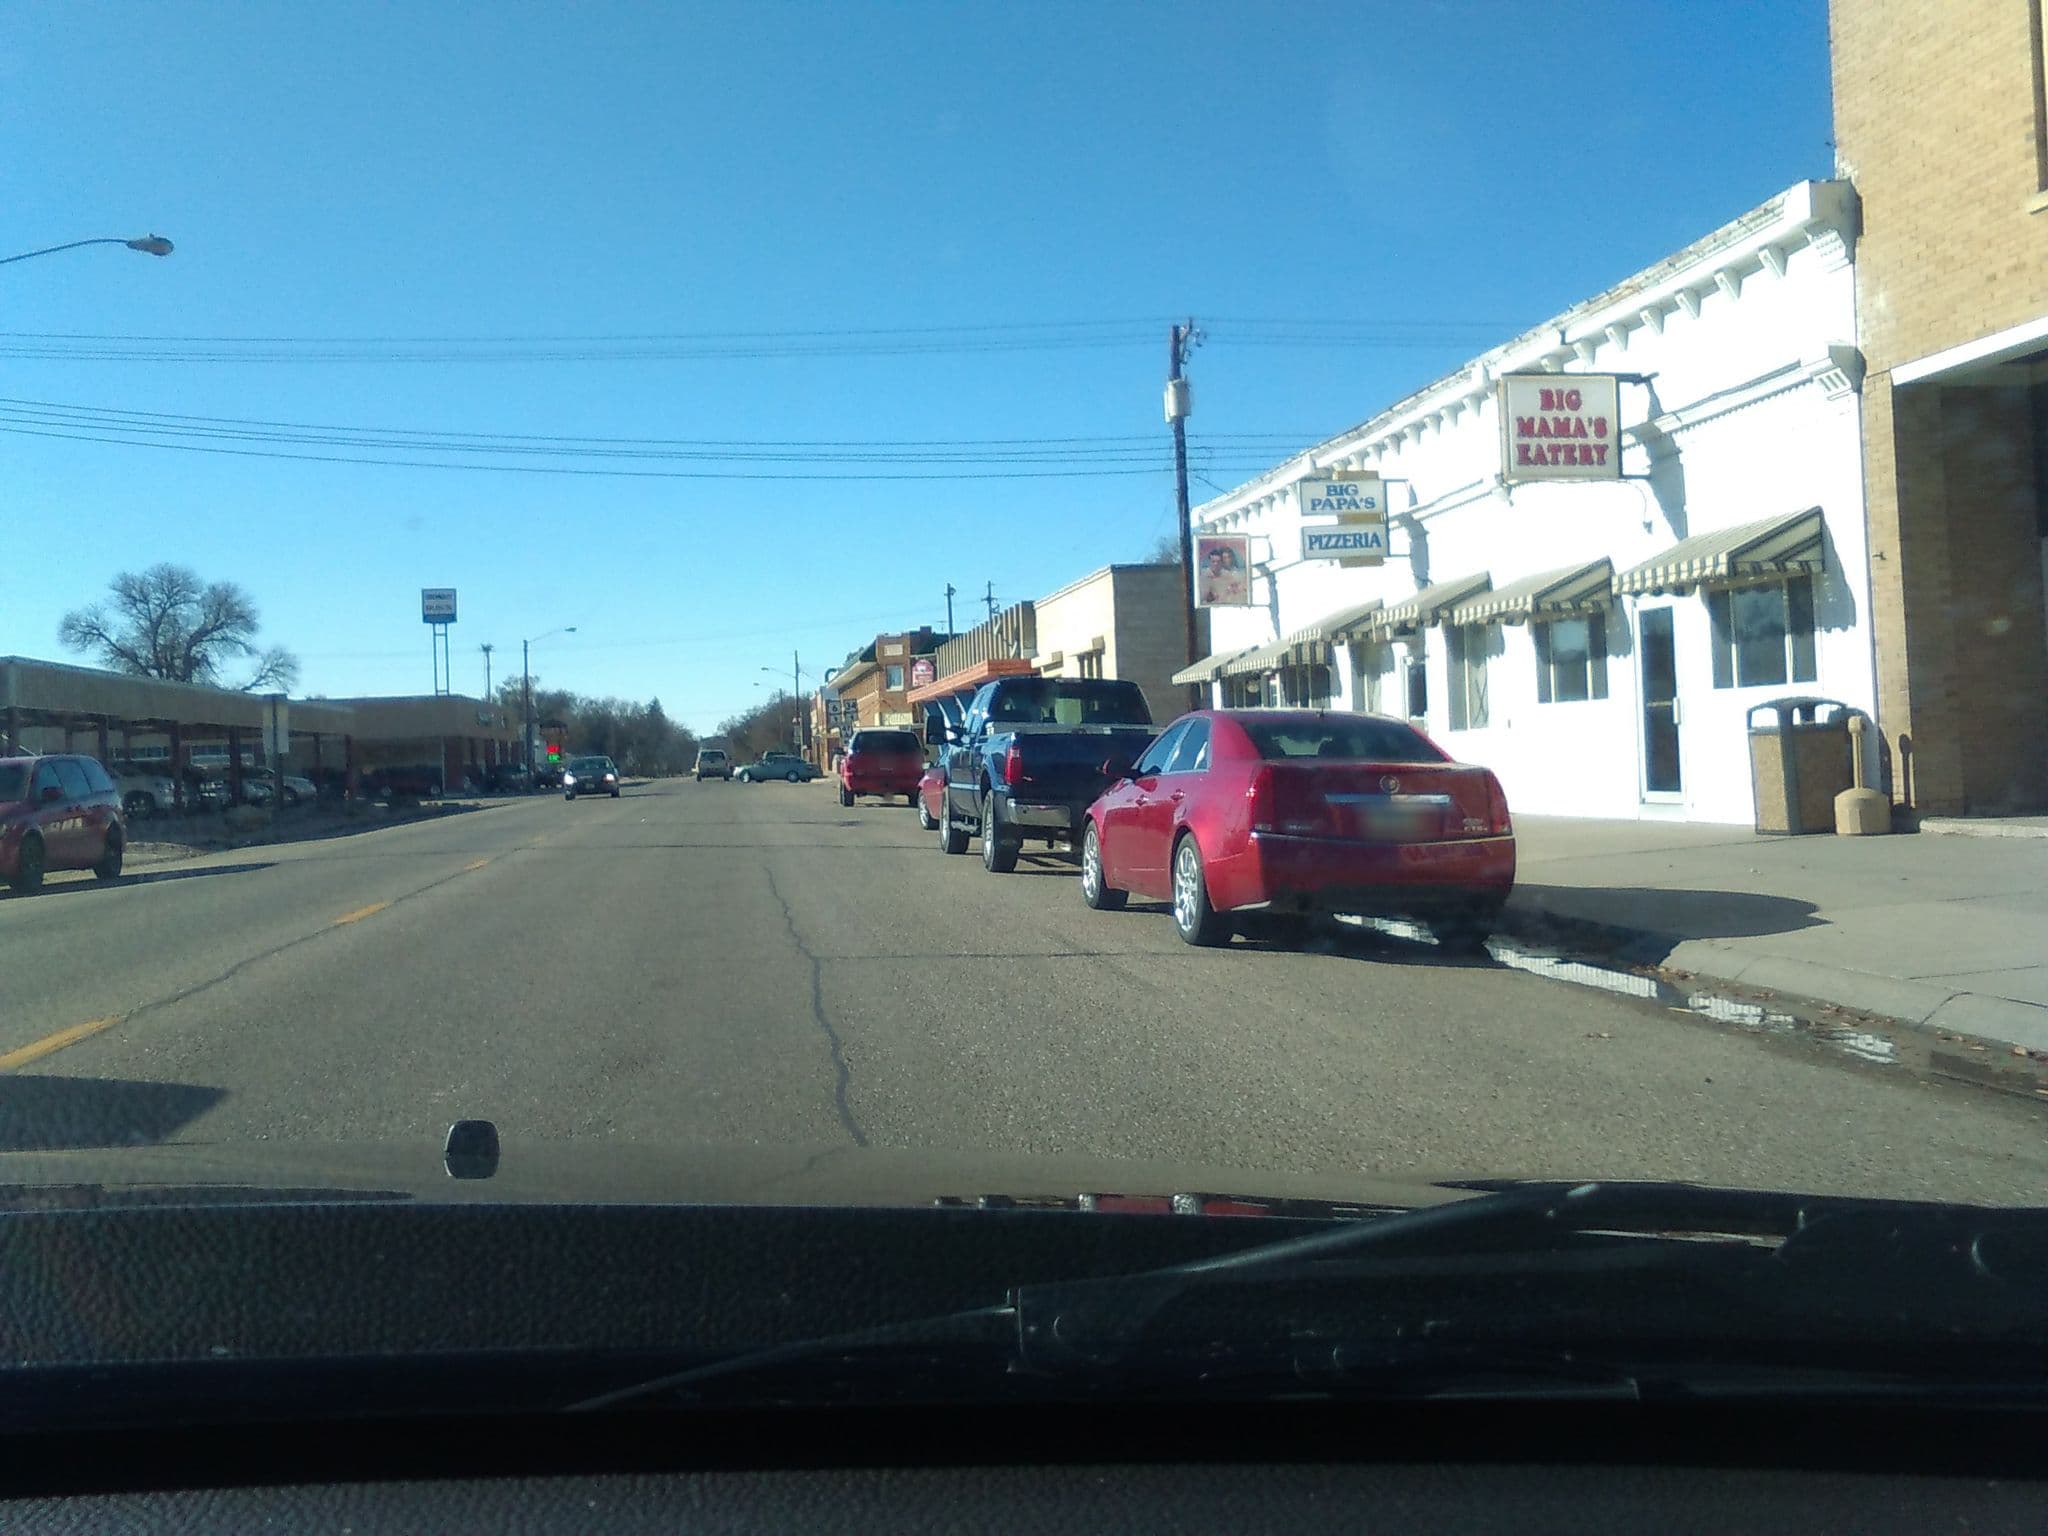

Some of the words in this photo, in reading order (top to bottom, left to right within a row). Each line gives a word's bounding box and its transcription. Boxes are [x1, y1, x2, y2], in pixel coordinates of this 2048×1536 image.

[1539, 388, 1582, 411] BIG
[1516, 416, 1608, 438] MAMA'S
[1516, 443, 1609, 465] EATERY
[1326, 484, 1359, 497] BIG
[1311, 497, 1376, 510] PAPA'S
[1308, 532, 1382, 550] PIZZERIA
